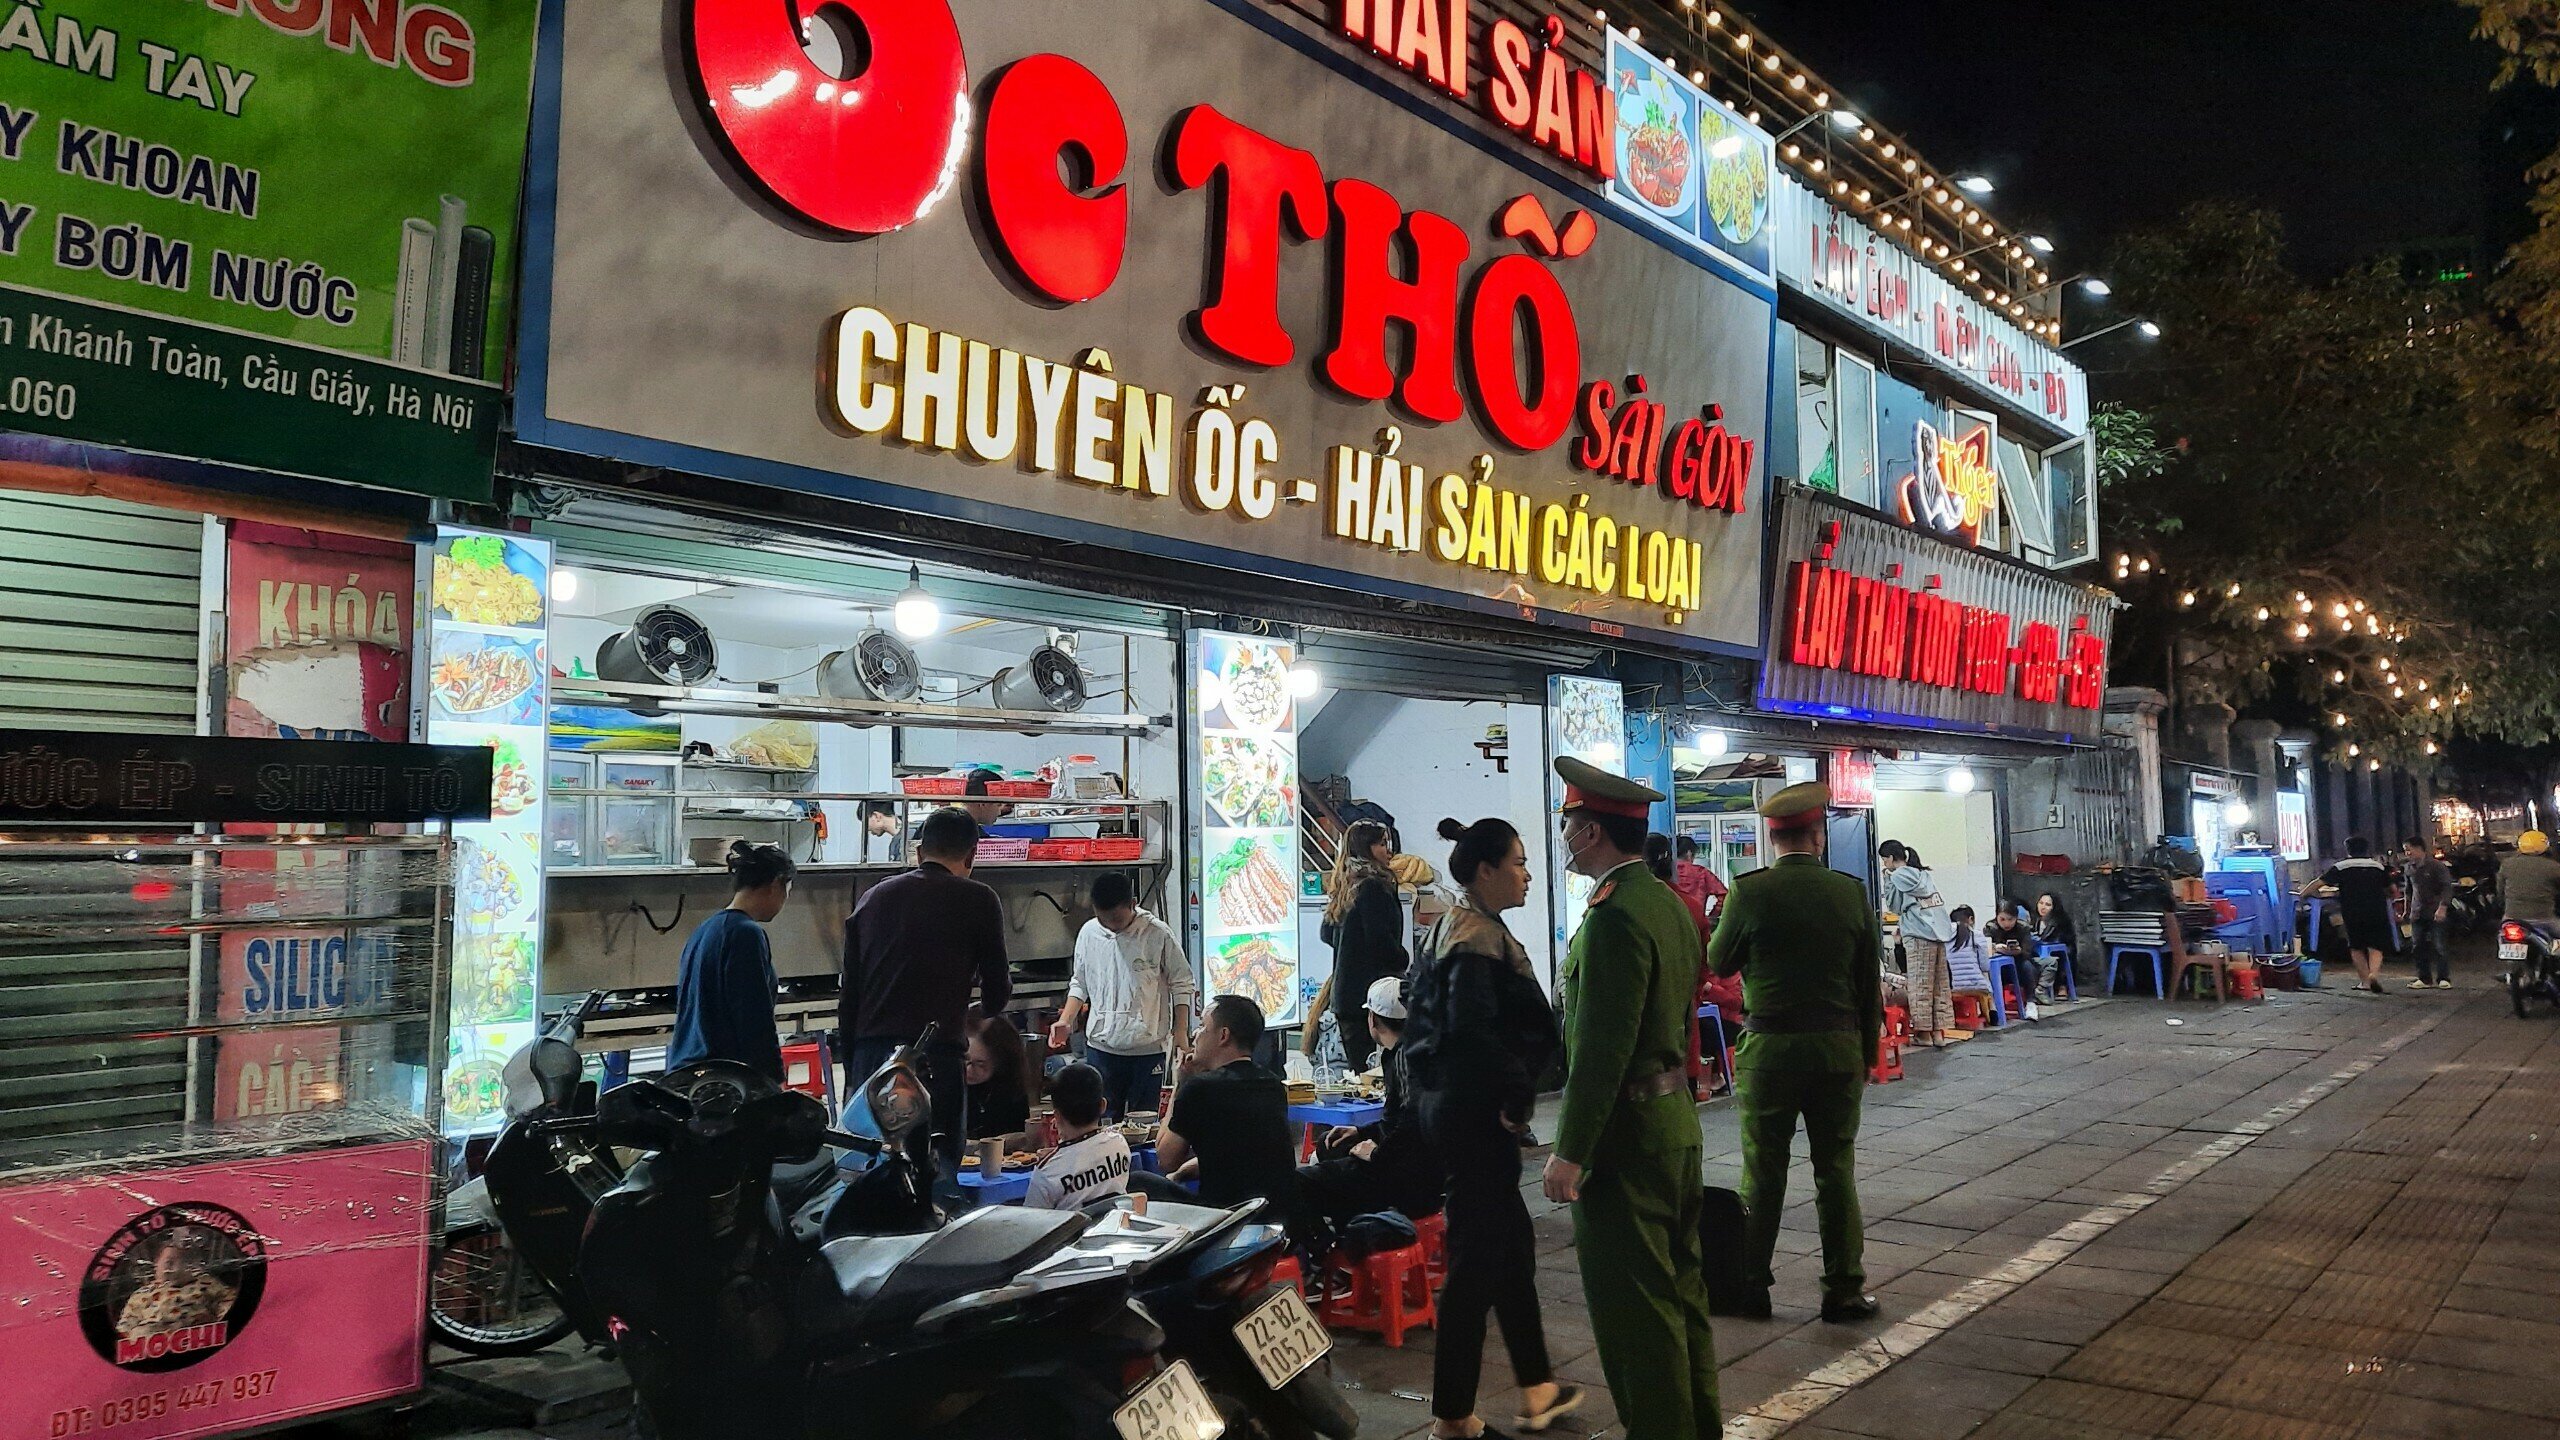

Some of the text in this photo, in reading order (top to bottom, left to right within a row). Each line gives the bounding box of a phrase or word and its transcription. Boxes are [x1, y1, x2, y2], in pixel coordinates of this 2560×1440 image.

[140, 41, 256, 117] TAY
[1486, 14, 1615, 180] SẢN
[59, 121, 259, 219] KHOAN
[56, 214, 192, 292] BƠM
[212, 247, 357, 327] NƯỚC
[28, 313, 133, 367] Khánh
[148, 336, 228, 390] Toàn,
[242, 353, 298, 396] Cầu
[310, 369, 376, 417] Giấy,
[387, 383, 421, 420] Hà
[432, 393, 475, 434] Nội
[832, 306, 1174, 497] CHUYÊN
[1190, 384, 1279, 519] ỐC
[1334, 425, 1424, 554] HẢI
[1436, 454, 1532, 575] SẢN
[1541, 493, 1617, 594] CÁC
[1625, 524, 1702, 625] LOẠI
[1576, 373, 1755, 494] SÀI GÒN
[1939, 435, 1998, 527] Tiger
[259, 573, 401, 648] KHÓA
[1852, 563, 1910, 680] THÁI
[119, 747, 196, 811] ÉP
[255, 761, 387, 814] SINH
[623, 778, 658, 787] SANAKY
[116, 1321, 228, 1365] MOCHI
[1260, 1320, 1325, 1381] 105.21
[102, 1390, 169, 1428] 0395
[176, 1379, 225, 1412] 447
[232, 1369, 279, 1400] 937
